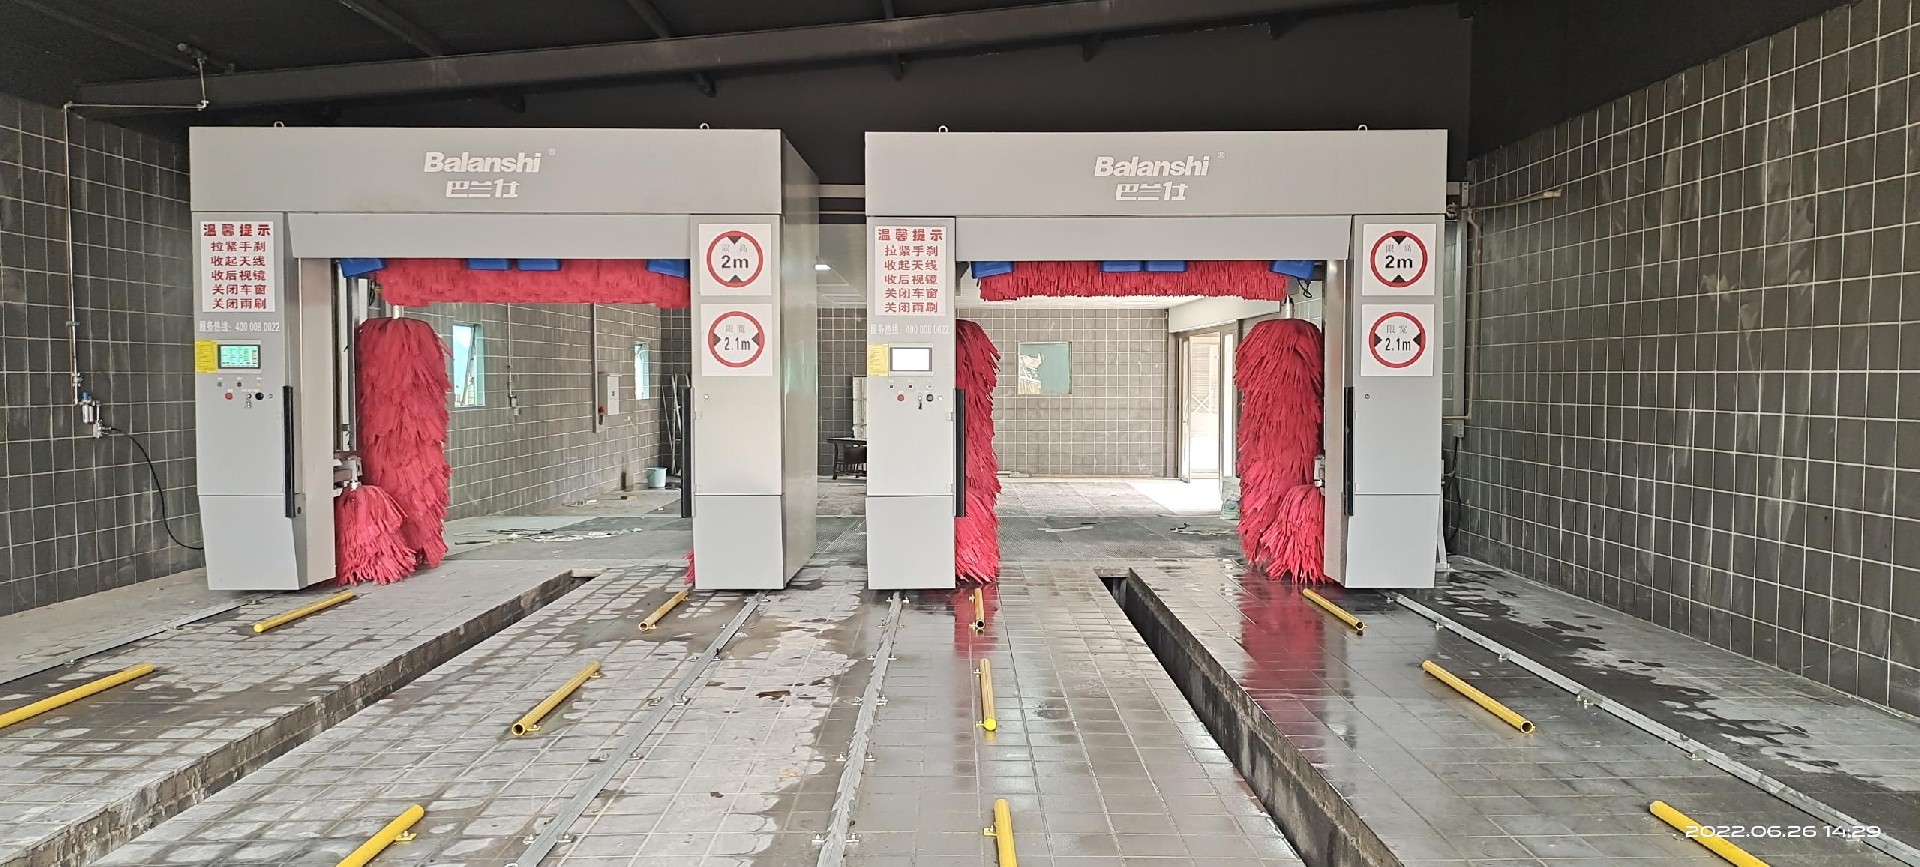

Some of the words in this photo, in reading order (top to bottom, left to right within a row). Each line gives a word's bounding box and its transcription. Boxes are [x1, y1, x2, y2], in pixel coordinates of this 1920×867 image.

[424, 151, 542, 173] Balanshi
[1094, 155, 1211, 177] Balanshi
[203, 223, 271, 237] 温馨提示
[878, 228, 943, 242] 温馨提示
[210, 241, 266, 252] 拉紧手刹
[884, 245, 939, 257] 拉紧手刹
[211, 256, 266, 267] 收起天线
[721, 254, 749, 269] 2m
[884, 260, 938, 271] 收起天线
[1385, 254, 1413, 269] 2m
[211, 270, 267, 281] 收后视镜
[884, 274, 939, 285] 收后视镜
[212, 284, 267, 295] 关闭车窗
[884, 288, 939, 299] 关闭车窗
[212, 298, 267, 310] 关闭雨刷
[884, 302, 938, 313] 关闭雨刷
[724, 336, 751, 351] 2.1m
[1385, 337, 1411, 351] 2.1m
